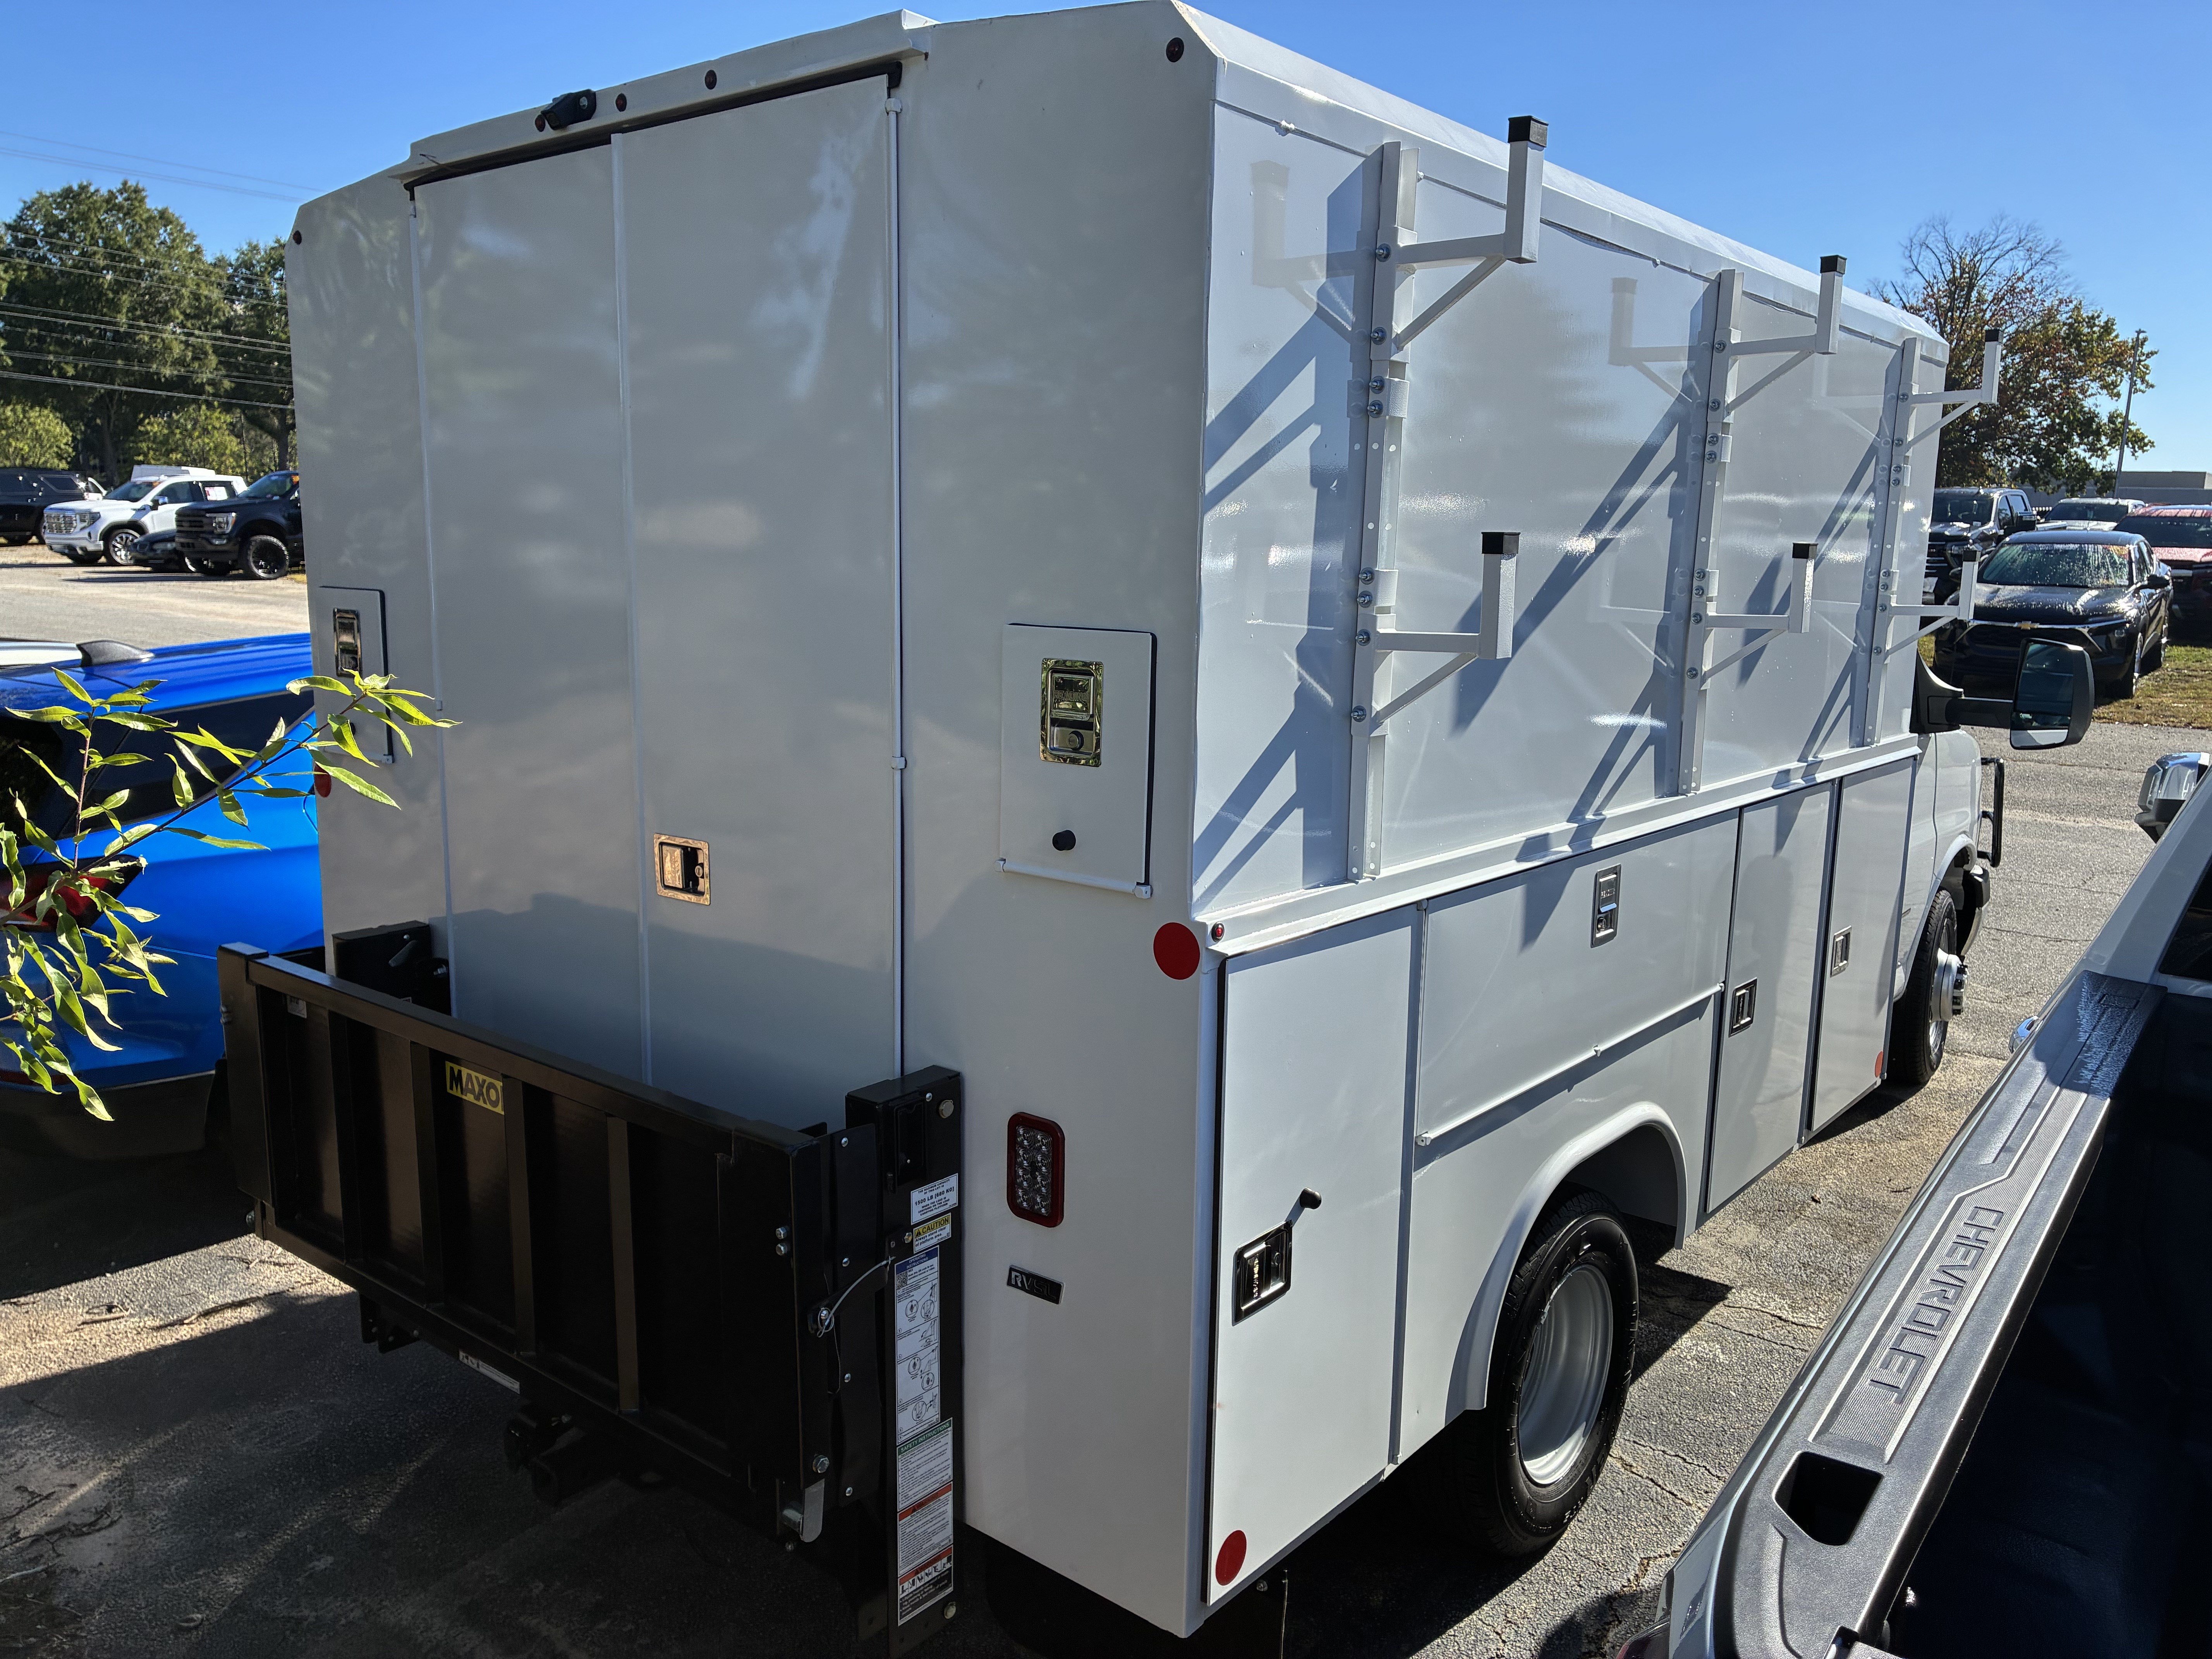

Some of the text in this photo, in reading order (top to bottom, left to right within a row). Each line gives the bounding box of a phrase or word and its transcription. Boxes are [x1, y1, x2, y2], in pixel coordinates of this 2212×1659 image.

[449, 1065, 503, 1111] MAXO
[915, 1198, 926, 1206] 1500
[922, 1216, 948, 1234] CAUTION
[1011, 1271, 1056, 1300] RVSL
[1869, 1206, 2004, 1405] CHEVROLET
[900, 1439, 918, 1453] SAFETY
[918, 1422, 950, 1443] INSTRUCTIONS
